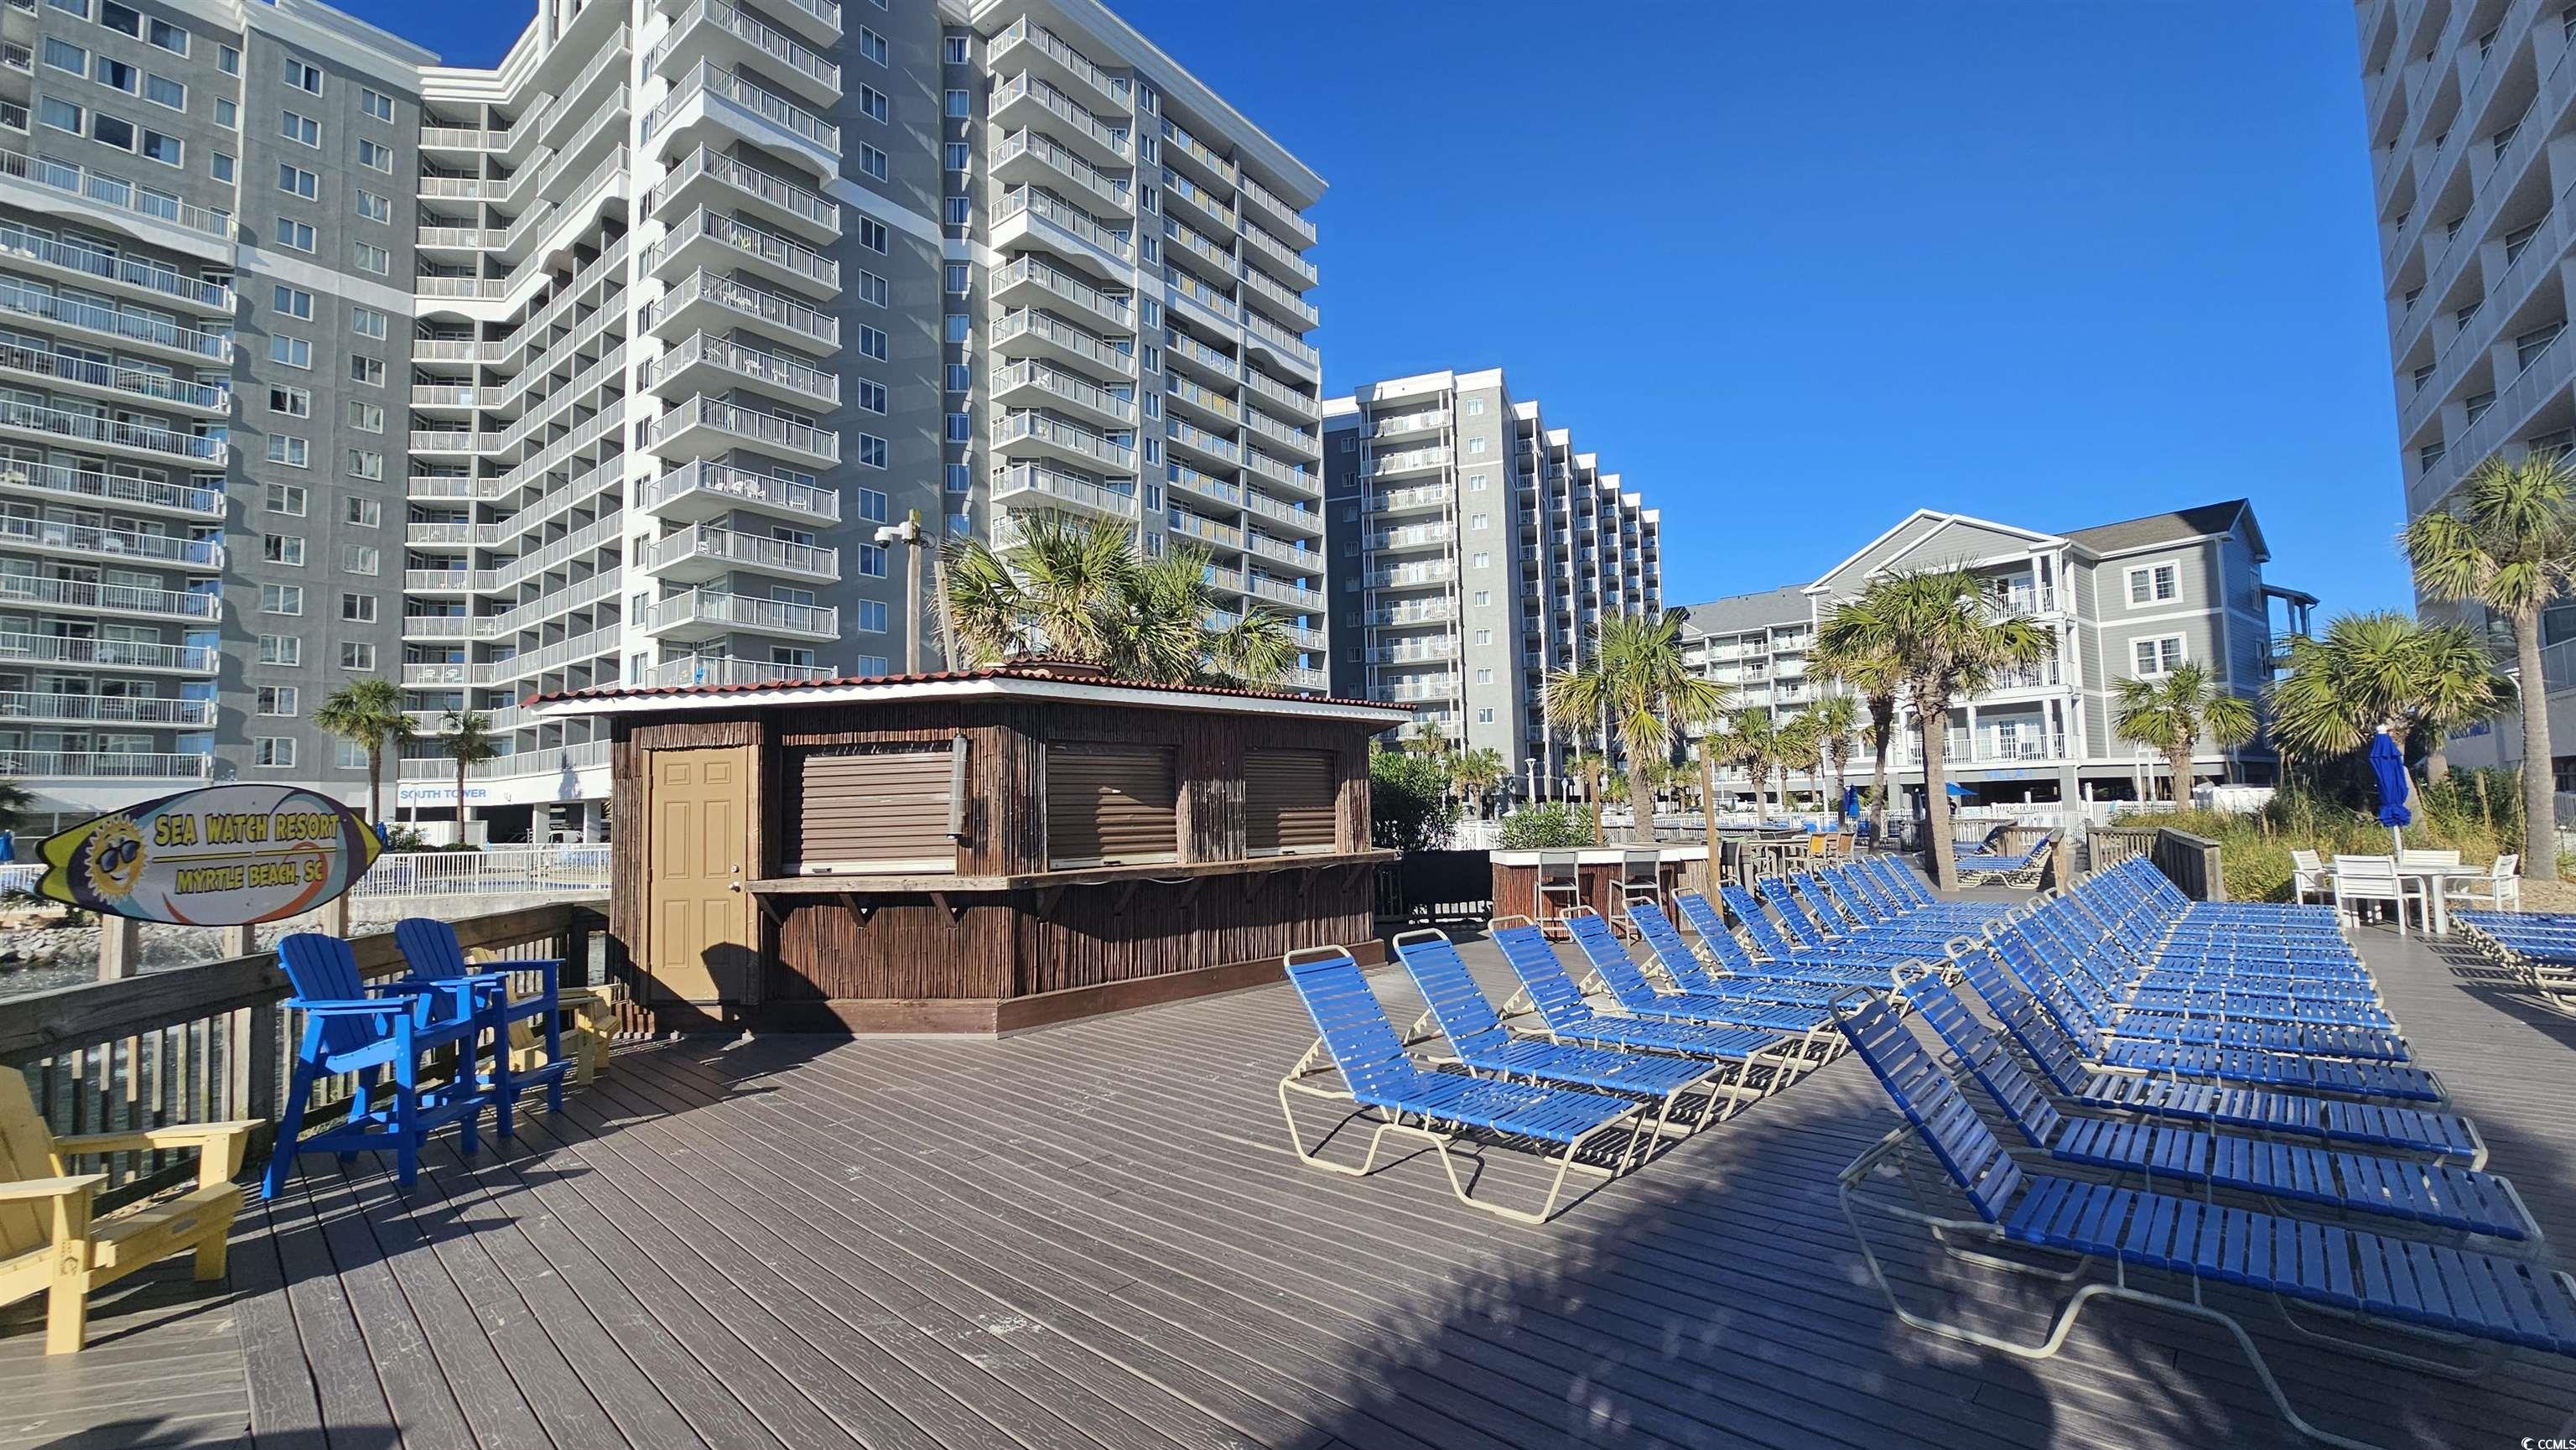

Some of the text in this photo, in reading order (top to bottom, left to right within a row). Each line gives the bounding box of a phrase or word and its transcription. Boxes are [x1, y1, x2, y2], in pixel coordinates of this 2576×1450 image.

[401, 789, 486, 799] SOUTH TOWER
[154, 813, 340, 846] SEA WATCH RESORT
[174, 860, 323, 895] MYRTLE BEACH, SC
